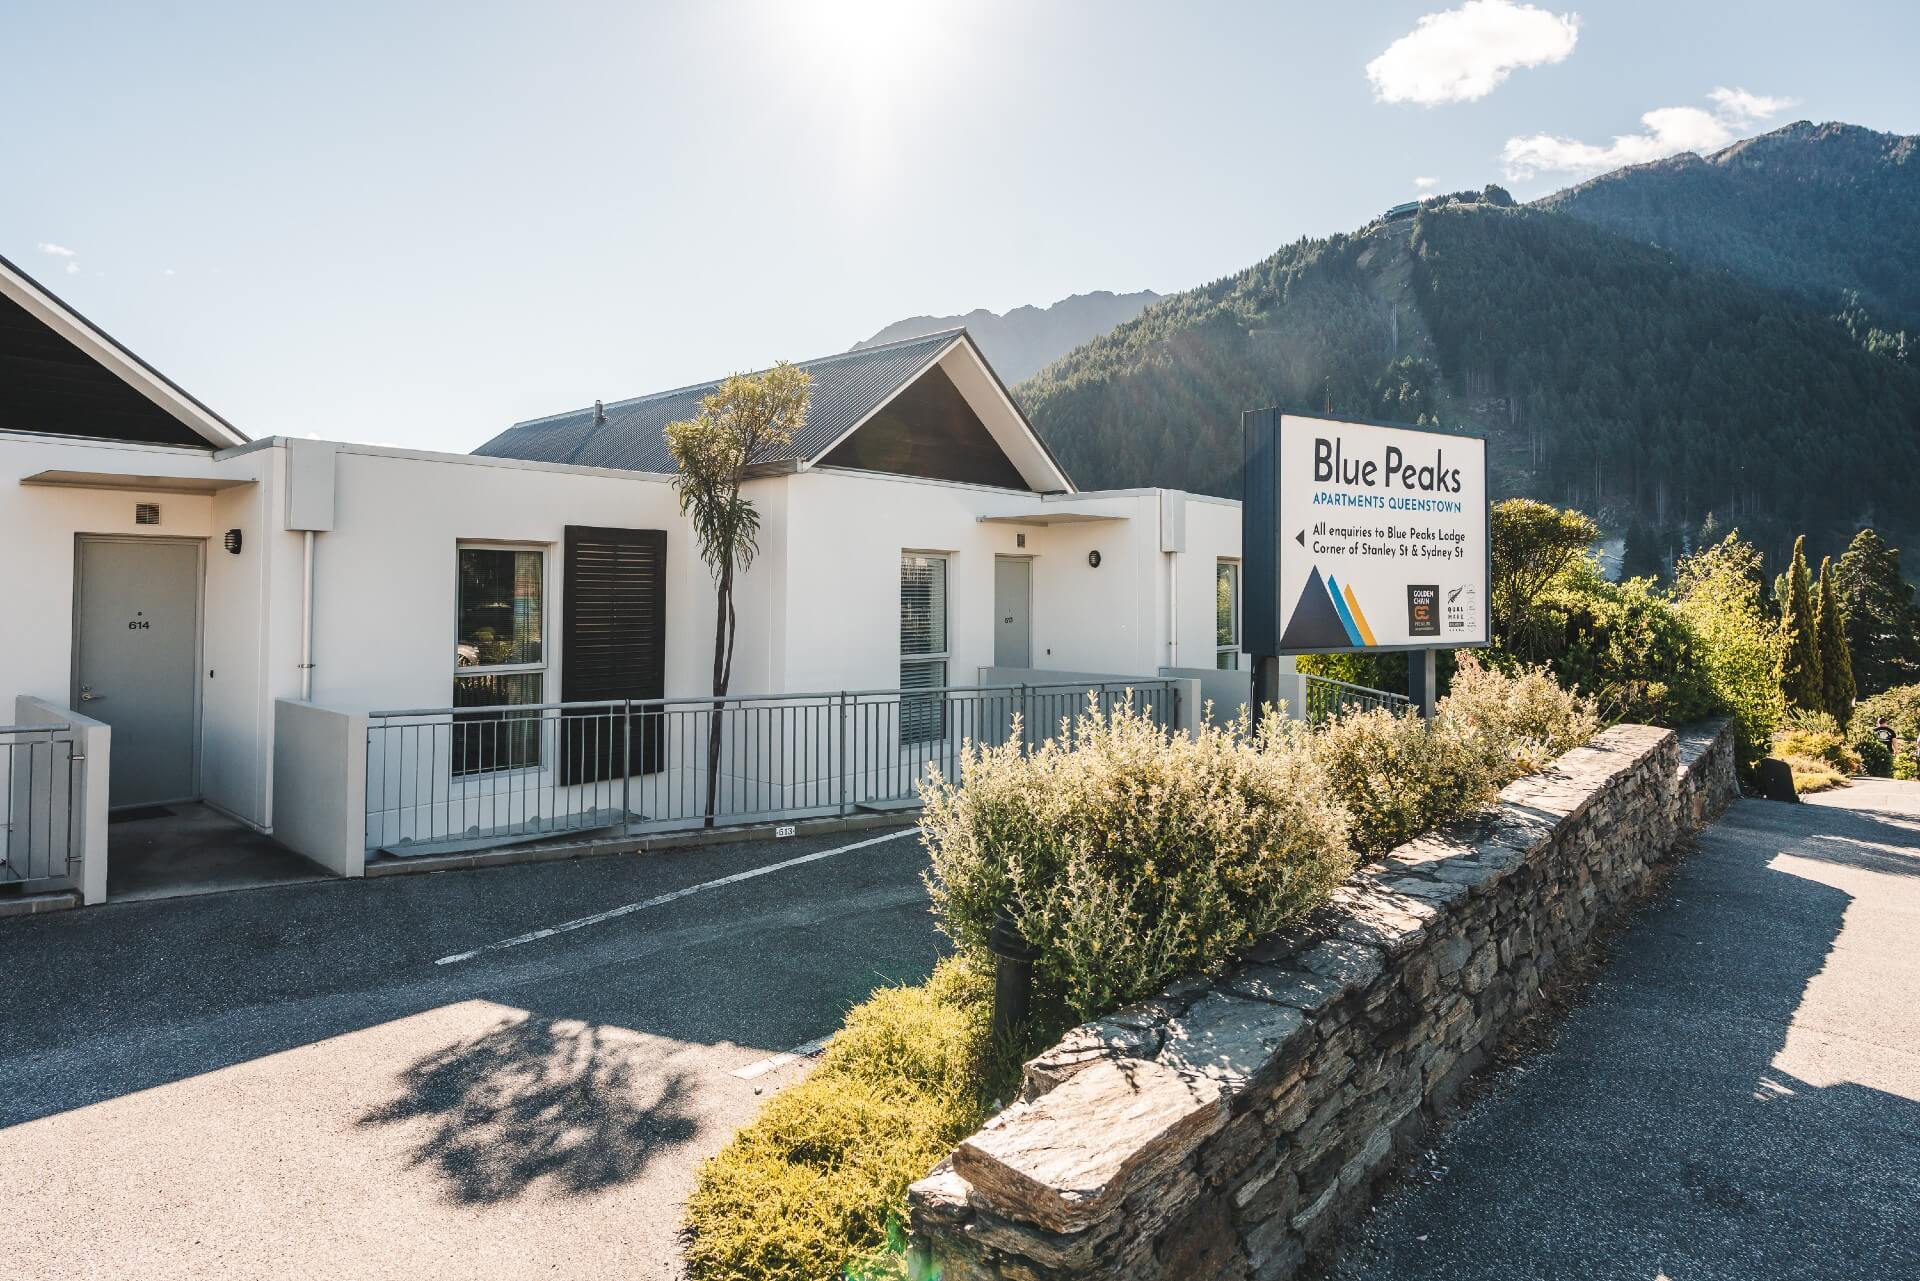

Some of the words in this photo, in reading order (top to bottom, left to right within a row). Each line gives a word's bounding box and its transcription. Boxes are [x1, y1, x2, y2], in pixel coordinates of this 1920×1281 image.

[1314, 437, 1377, 487] Blue
[1385, 445, 1461, 493] Peaks
[1313, 492, 1384, 509] APARTMENTS
[1388, 496, 1461, 513] QUEENSTOWN
[1312, 521, 1326, 536] All
[1328, 525, 1372, 540] enquiries
[1375, 527, 1385, 538] to
[1387, 525, 1407, 539] Blue
[1410, 527, 1436, 540] Peaks
[1438, 528, 1466, 544] Lodge
[1313, 540, 1346, 554] Corner
[1348, 541, 1359, 555] of
[1362, 542, 1396, 559] Stanley
[1399, 544, 1409, 557] St
[1411, 544, 1419, 557] &
[1421, 544, 1452, 561] Sydney
[1455, 546, 1464, 558] St
[129, 621, 150, 630] 614
